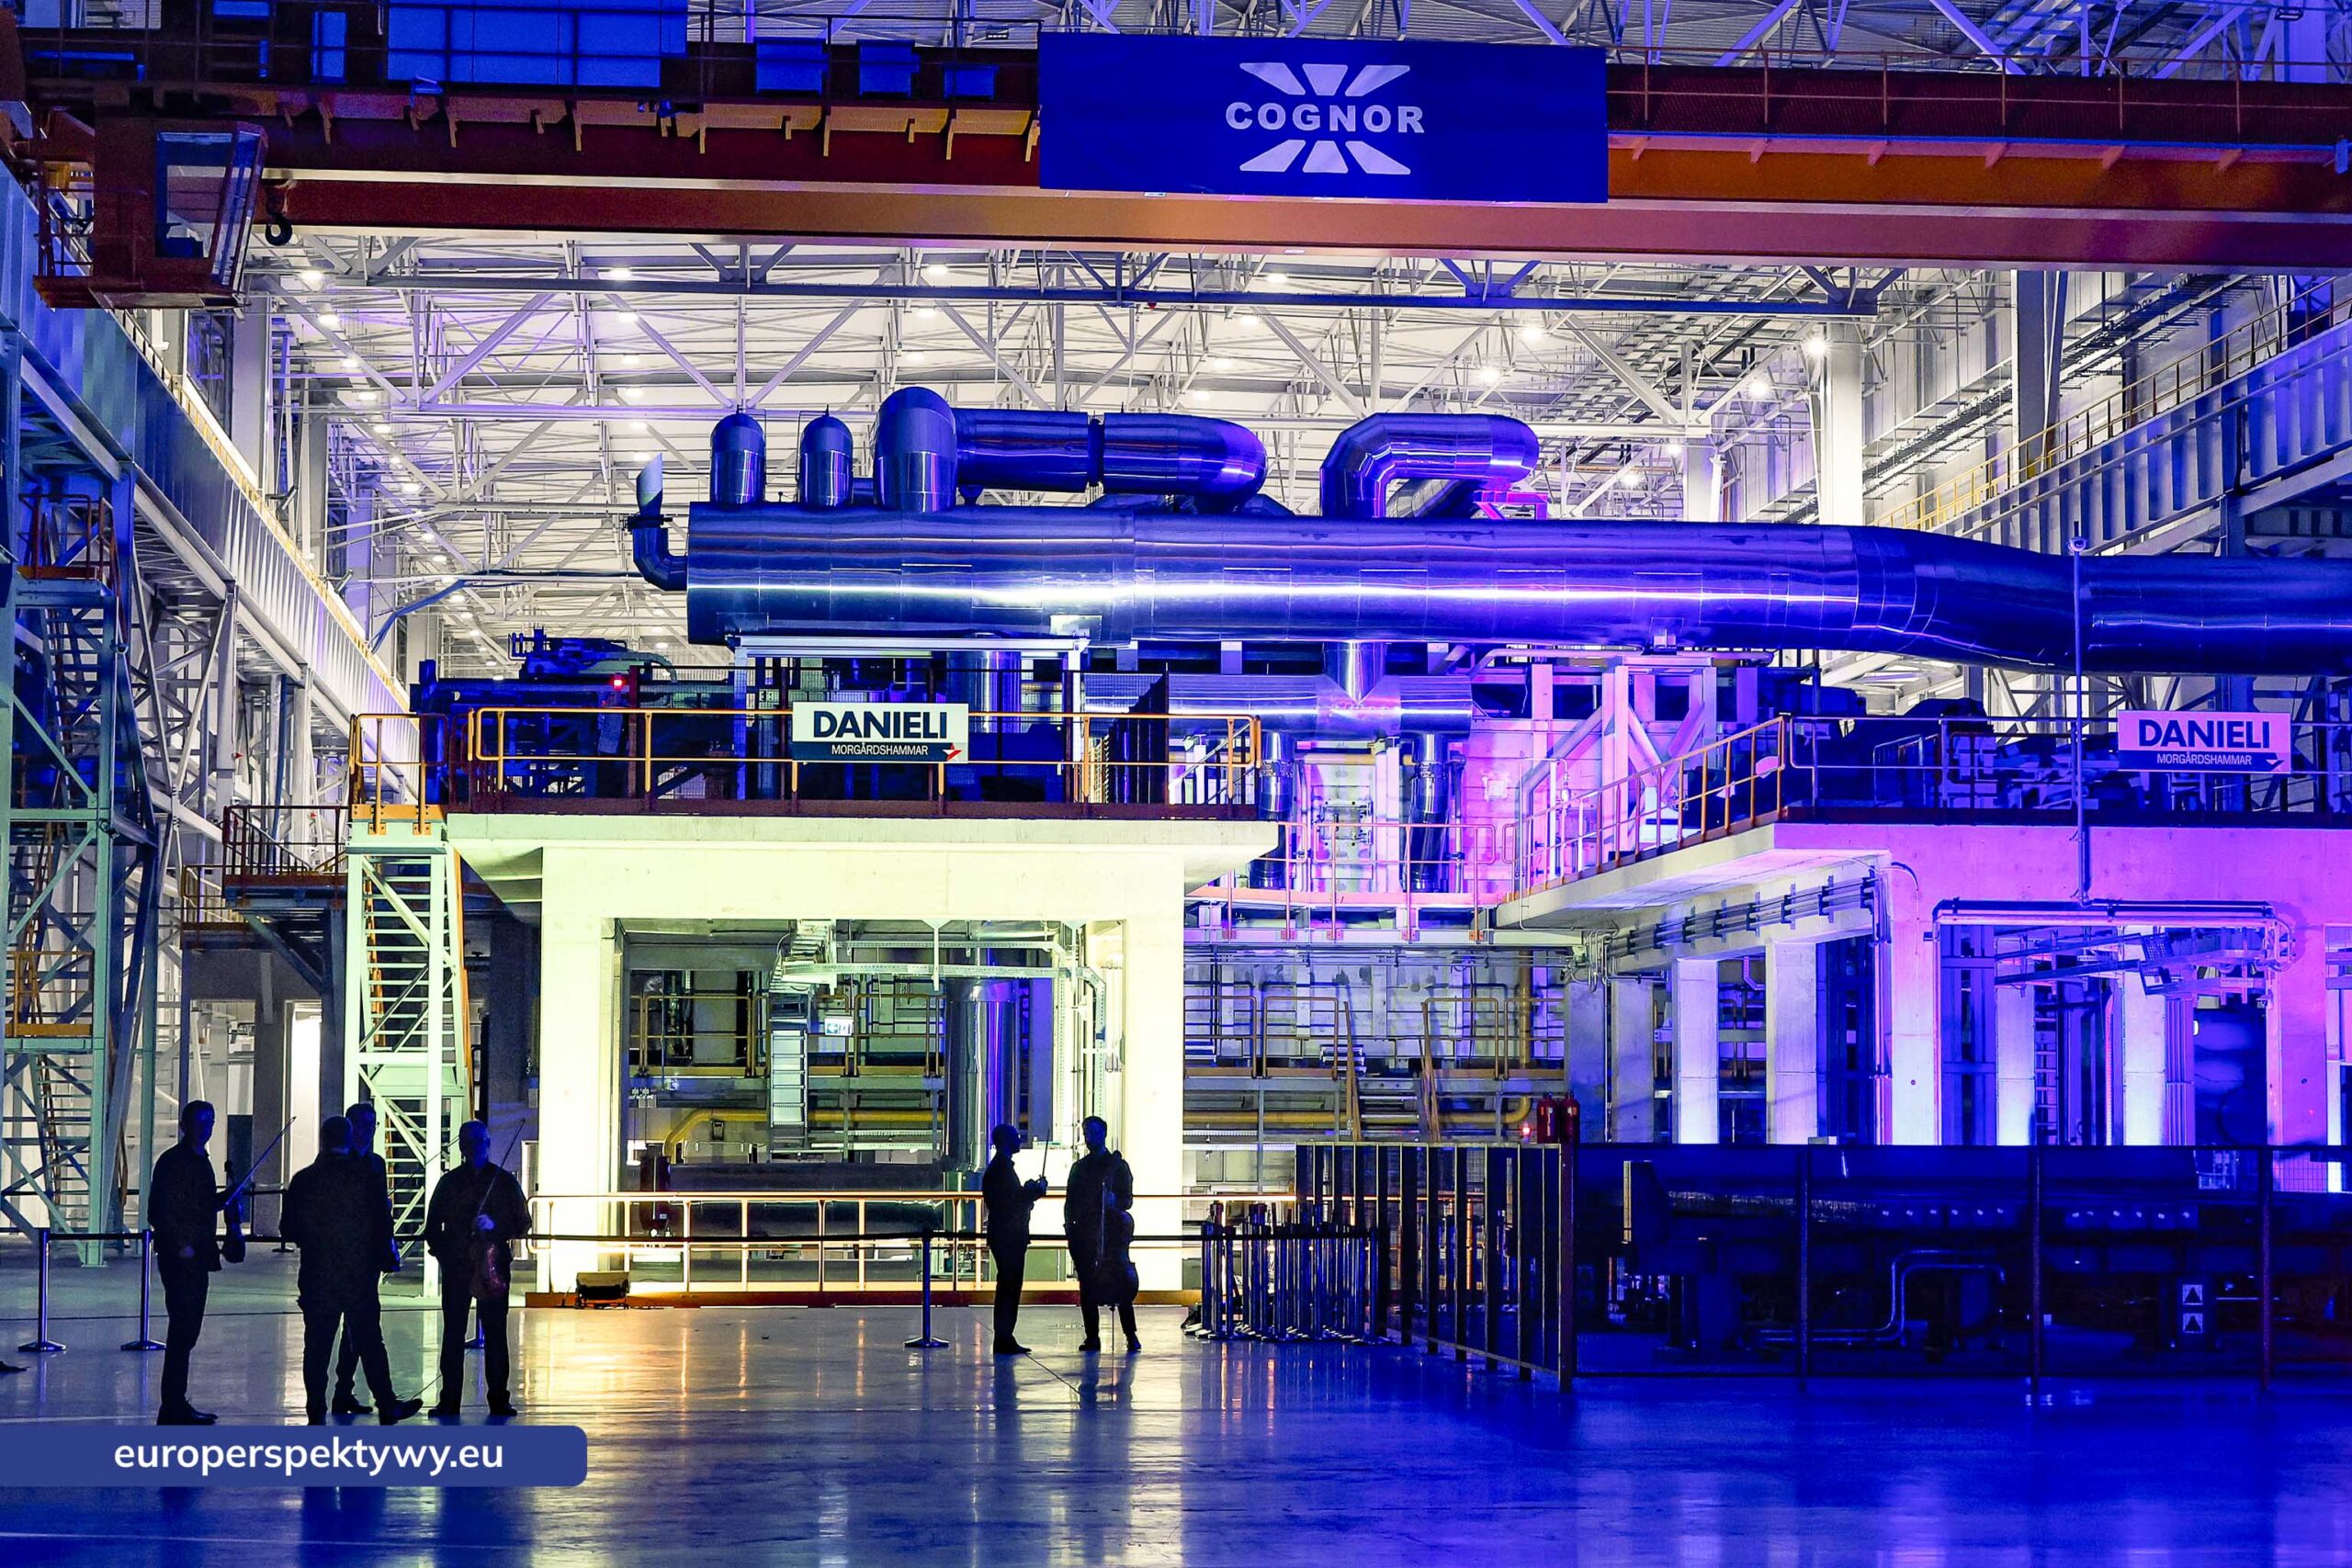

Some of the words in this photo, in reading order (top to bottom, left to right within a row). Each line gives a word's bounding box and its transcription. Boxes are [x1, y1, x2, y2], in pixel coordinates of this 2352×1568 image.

[1226, 102, 1425, 133] COGNOR
[813, 711, 947, 739] DANIELI
[2138, 719, 2270, 749] DANIELI
[831, 742, 929, 755] MORGÅRDSHAMMAR
[2156, 751, 2252, 765] MORGÅRDSHAMMAR
